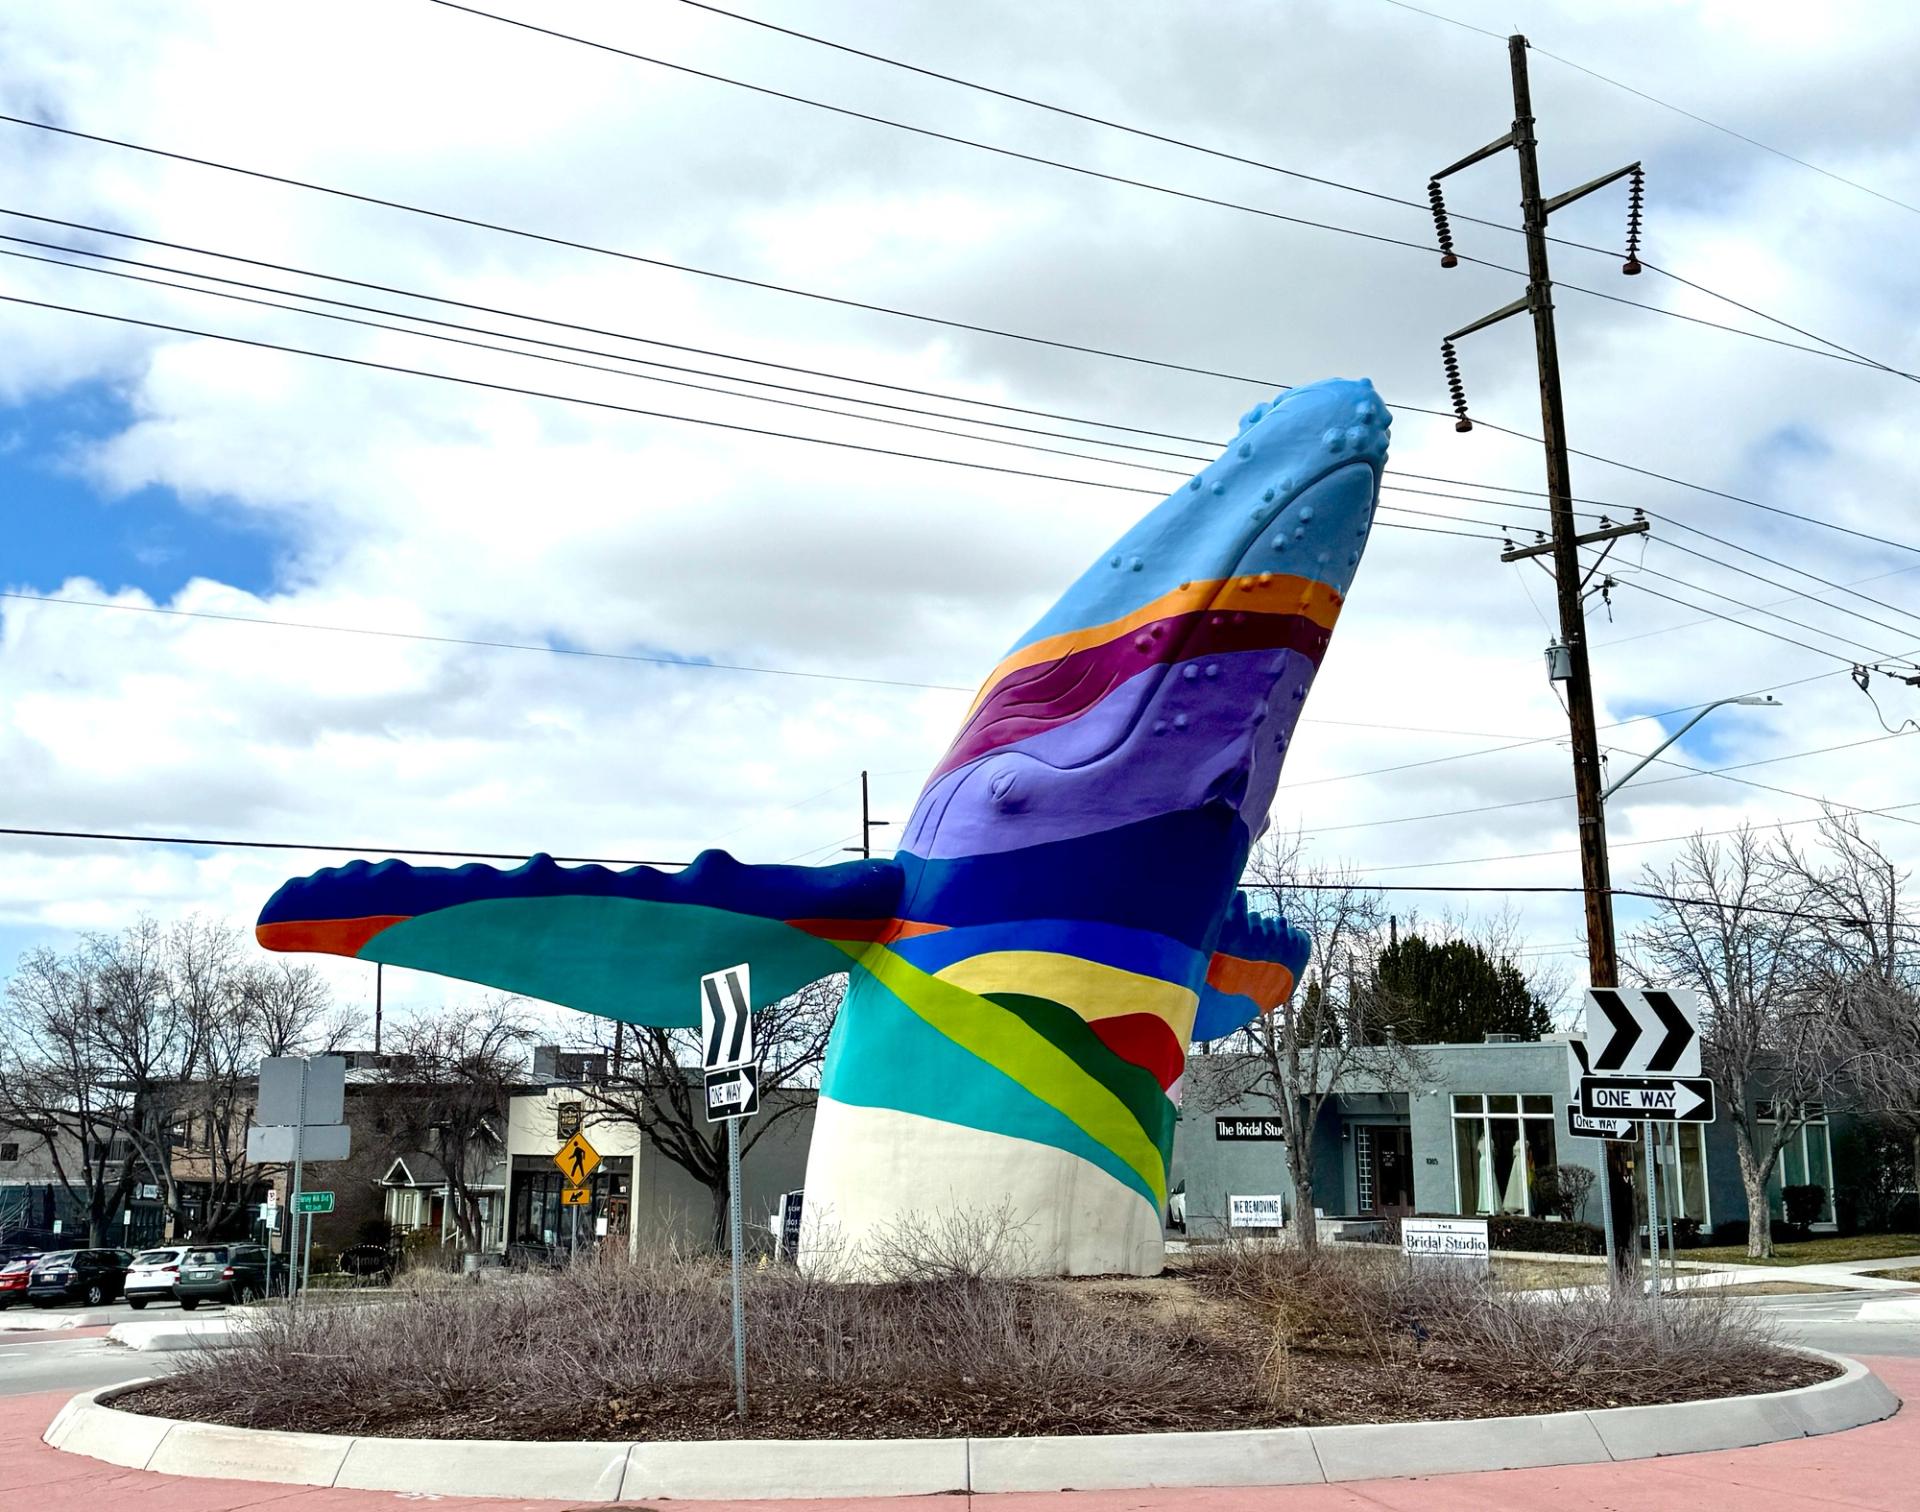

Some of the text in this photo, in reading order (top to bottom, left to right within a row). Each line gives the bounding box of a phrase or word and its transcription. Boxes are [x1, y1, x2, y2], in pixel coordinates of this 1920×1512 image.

[711, 1082, 742, 1105] ONE WAY
[1596, 1090, 1677, 1108] ONE WAY
[1217, 1121, 1234, 1136] The
[1236, 1121, 1262, 1136] Bridal
[1576, 1115, 1618, 1130] ONE WAY
[1253, 1200, 1279, 1213] MOVING
[1406, 1235, 1486, 1250] Bridal Studio
